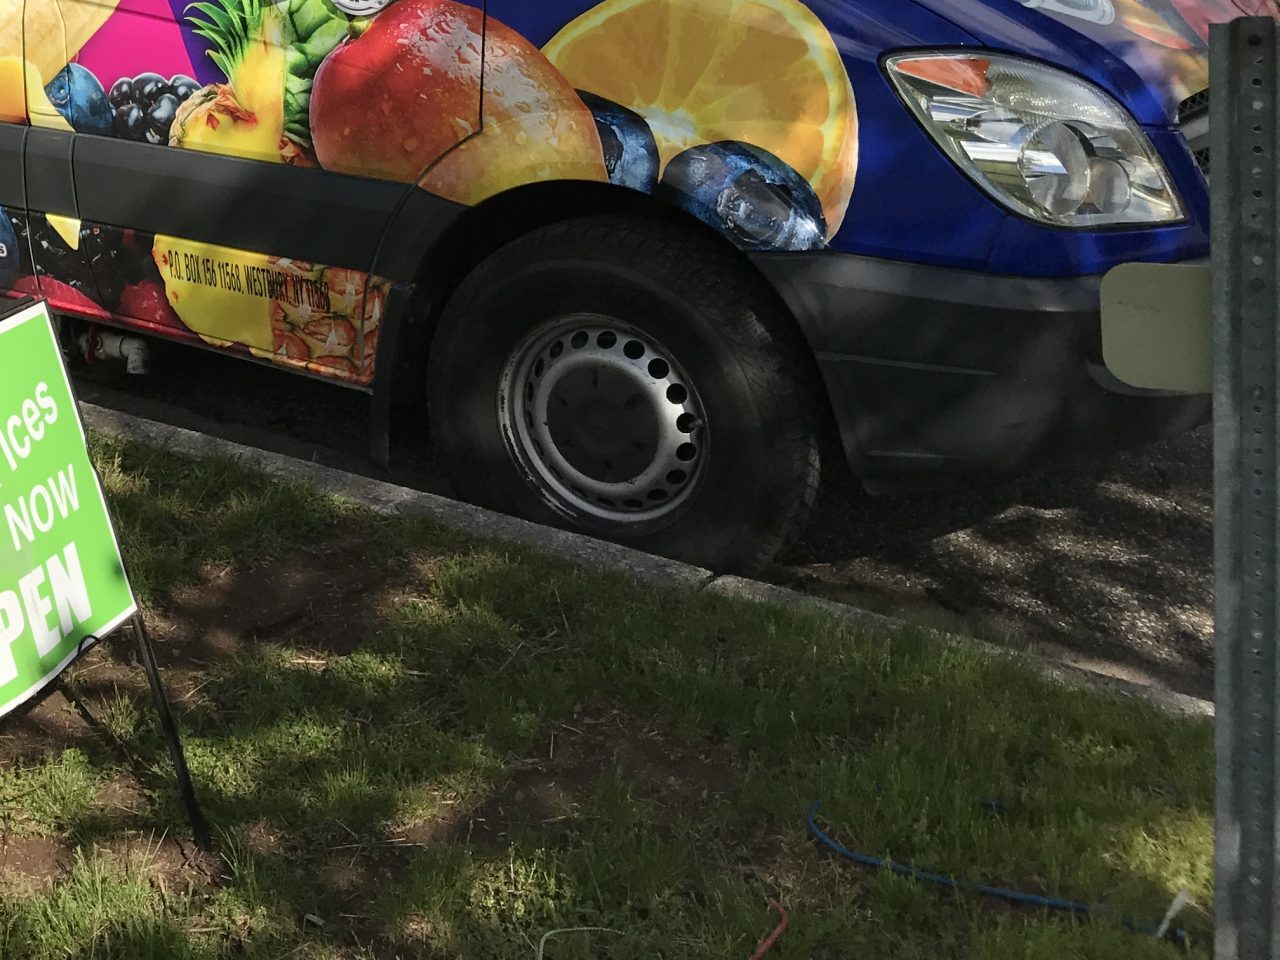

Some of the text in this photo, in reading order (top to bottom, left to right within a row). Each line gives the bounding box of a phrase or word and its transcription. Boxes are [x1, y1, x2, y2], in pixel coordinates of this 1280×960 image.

[168, 249, 184, 281] P.O.
[184, 252, 202, 285] BOX
[2, 462, 81, 552] NOW
